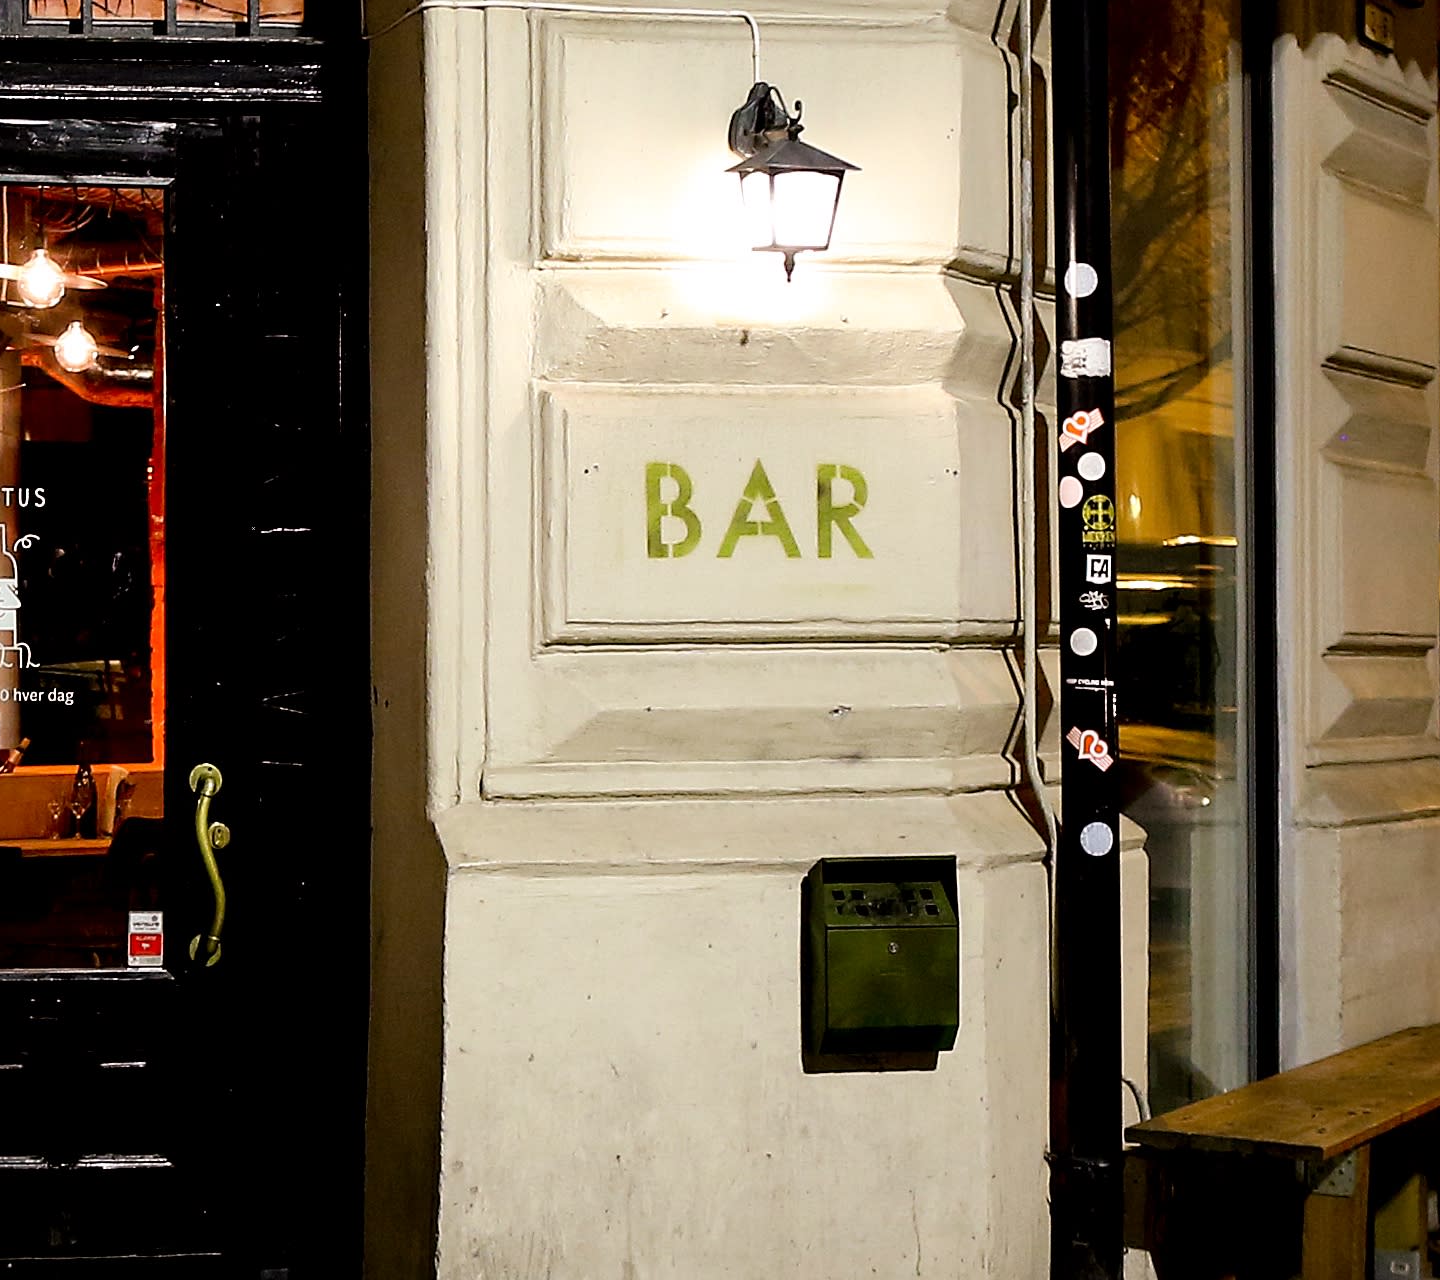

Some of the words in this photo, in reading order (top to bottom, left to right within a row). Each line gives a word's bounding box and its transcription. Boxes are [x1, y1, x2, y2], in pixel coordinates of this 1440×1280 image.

[645, 457, 875, 559] BAR
[13, 688, 44, 702] hver
[47, 687, 75, 706] dag
